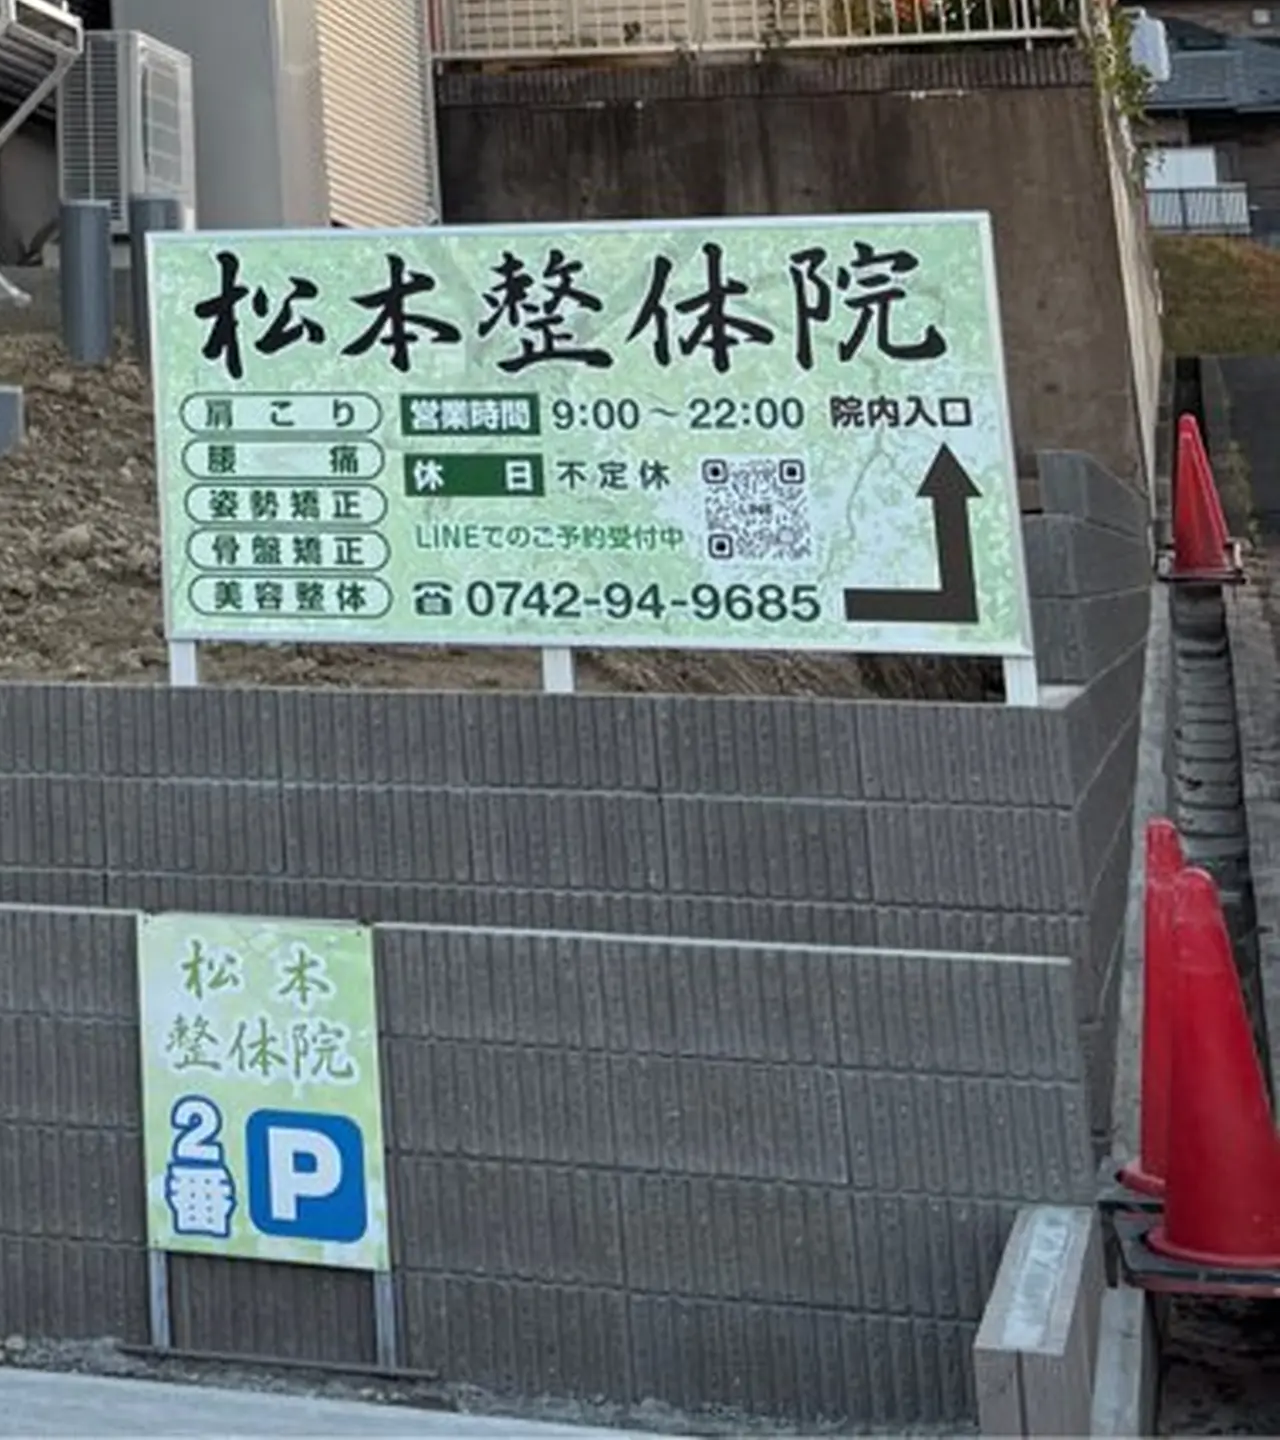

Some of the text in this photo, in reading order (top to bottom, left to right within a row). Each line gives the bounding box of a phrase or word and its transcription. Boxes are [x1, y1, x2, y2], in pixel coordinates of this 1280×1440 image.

[193, 241, 947, 379] 松本整体院
[204, 398, 357, 429] 肩こり
[409, 398, 533, 431] 営業時間
[828, 395, 974, 429] 院内入口
[206, 444, 360, 475] 腰痛
[412, 459, 535, 492] 休日
[556, 460, 671, 492] 不定休
[209, 489, 363, 520] 姿勢矯正
[212, 534, 366, 565] 骨盤矯正
[415, 523, 684, 552] LINEでのご予約受付中
[214, 580, 368, 612] 美容整体
[465, 580, 823, 623] 0742-94-9685
[180, 938, 330, 1005] 松本
[164, 1011, 355, 1080] 整体院
[267, 1124, 343, 1221] P
